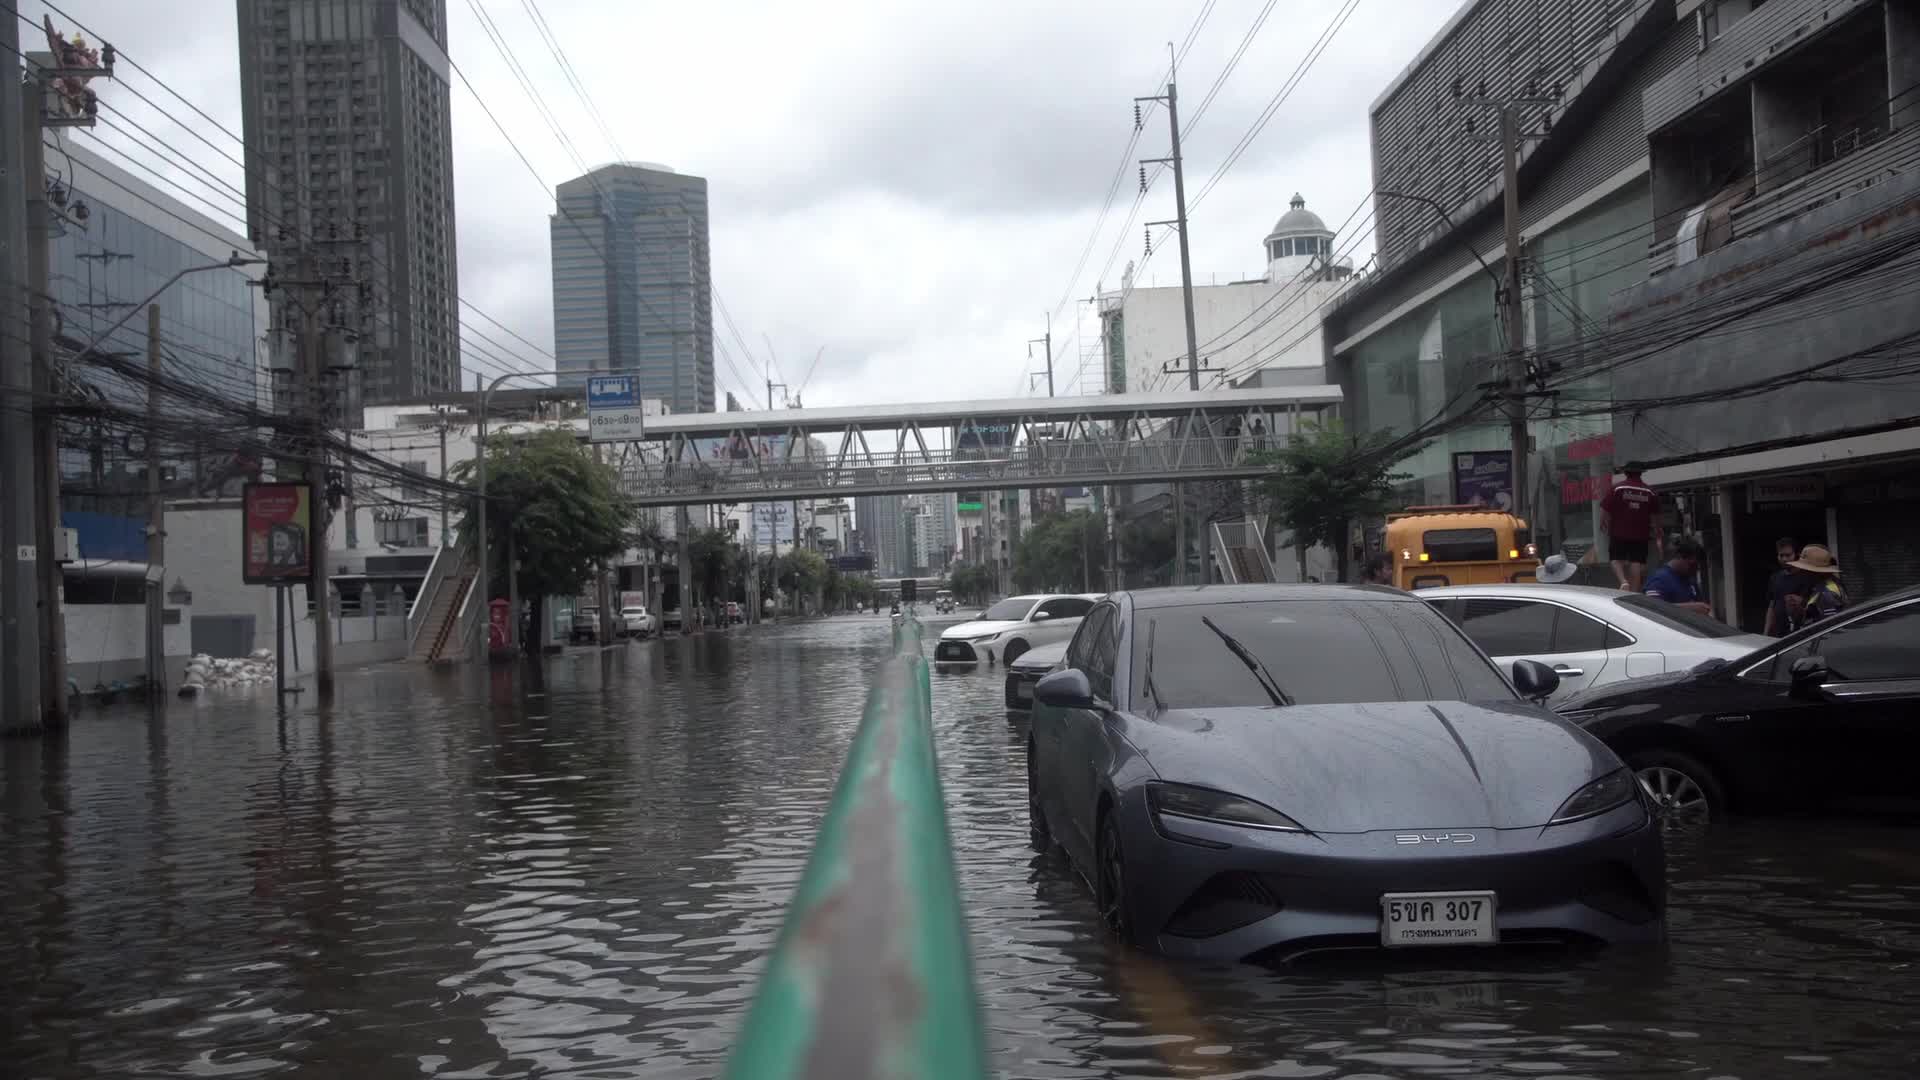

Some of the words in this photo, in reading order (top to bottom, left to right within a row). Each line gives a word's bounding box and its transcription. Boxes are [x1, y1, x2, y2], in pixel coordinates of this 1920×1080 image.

[1396, 833, 1476, 845] BYD
[1390, 901, 1434, 922] 5ขค
[1446, 901, 1482, 921] 307
[1402, 928, 1477, 941] กรุงเทพมหานคร
